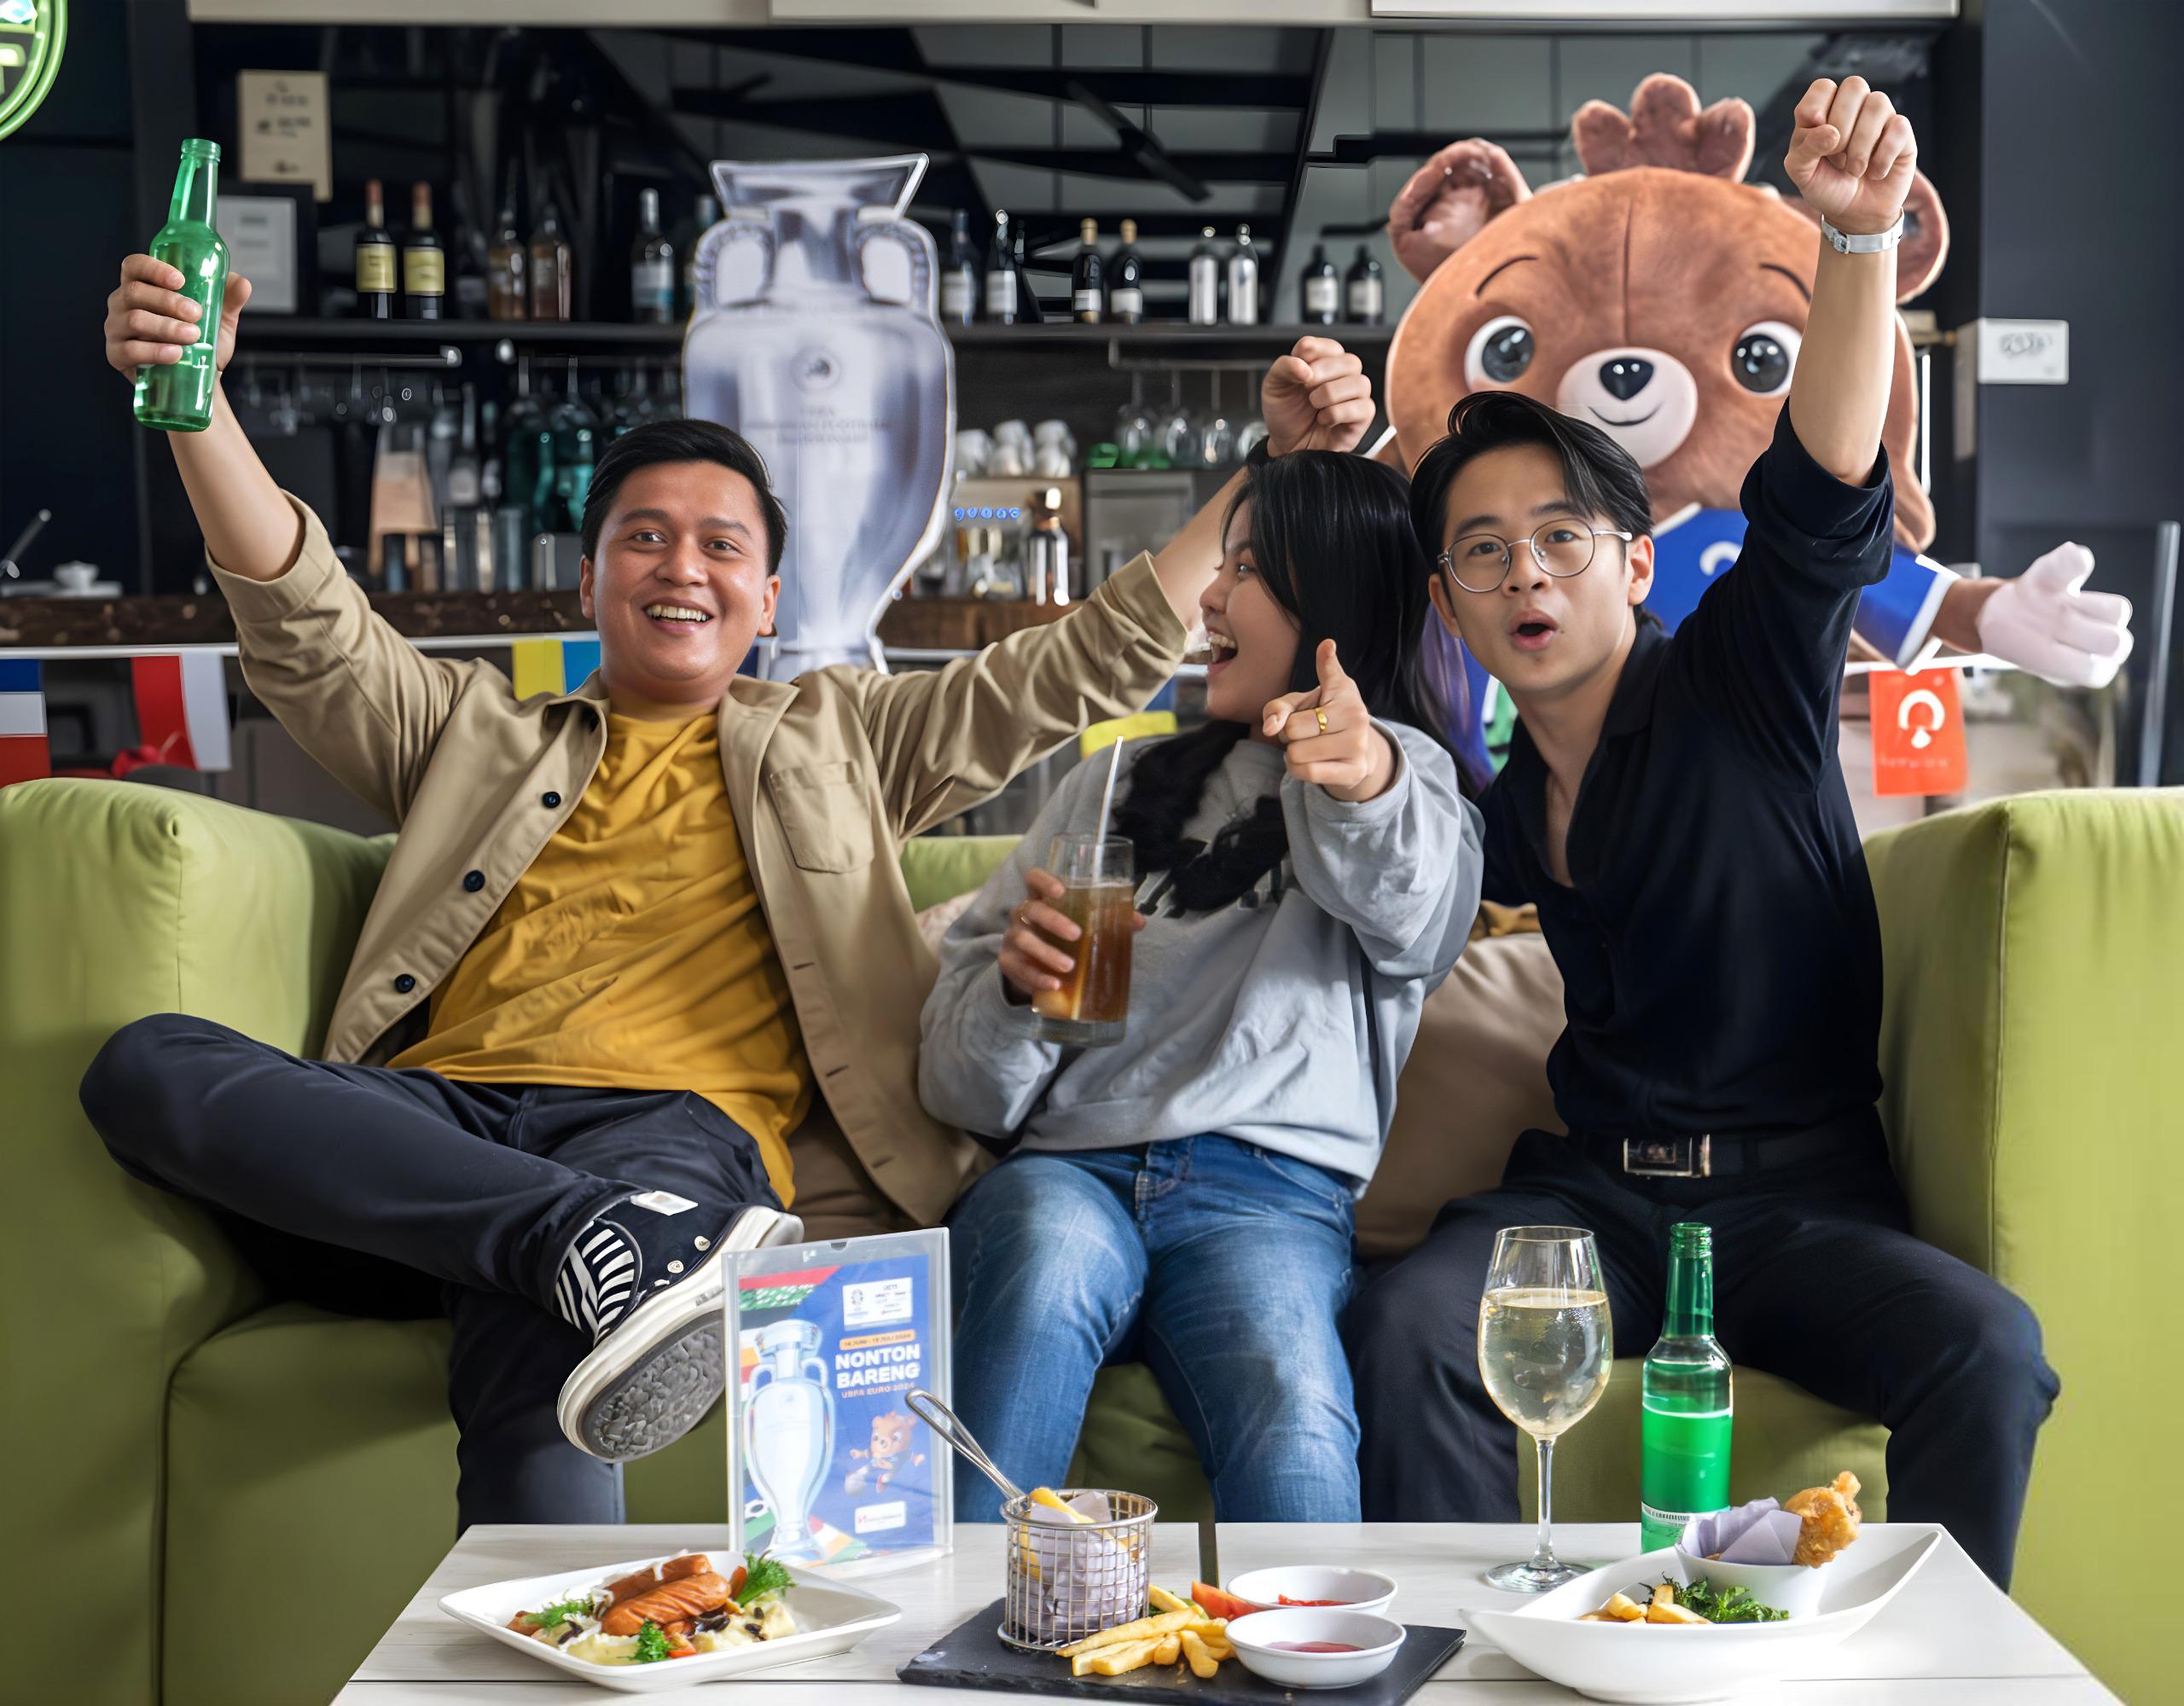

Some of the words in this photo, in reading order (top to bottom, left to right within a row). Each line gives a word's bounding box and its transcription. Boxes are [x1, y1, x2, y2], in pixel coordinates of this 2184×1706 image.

[835, 1343, 920, 1370] NONTON
[836, 1362, 921, 1389] BARENG
[866, 1386, 891, 1396] EURO
